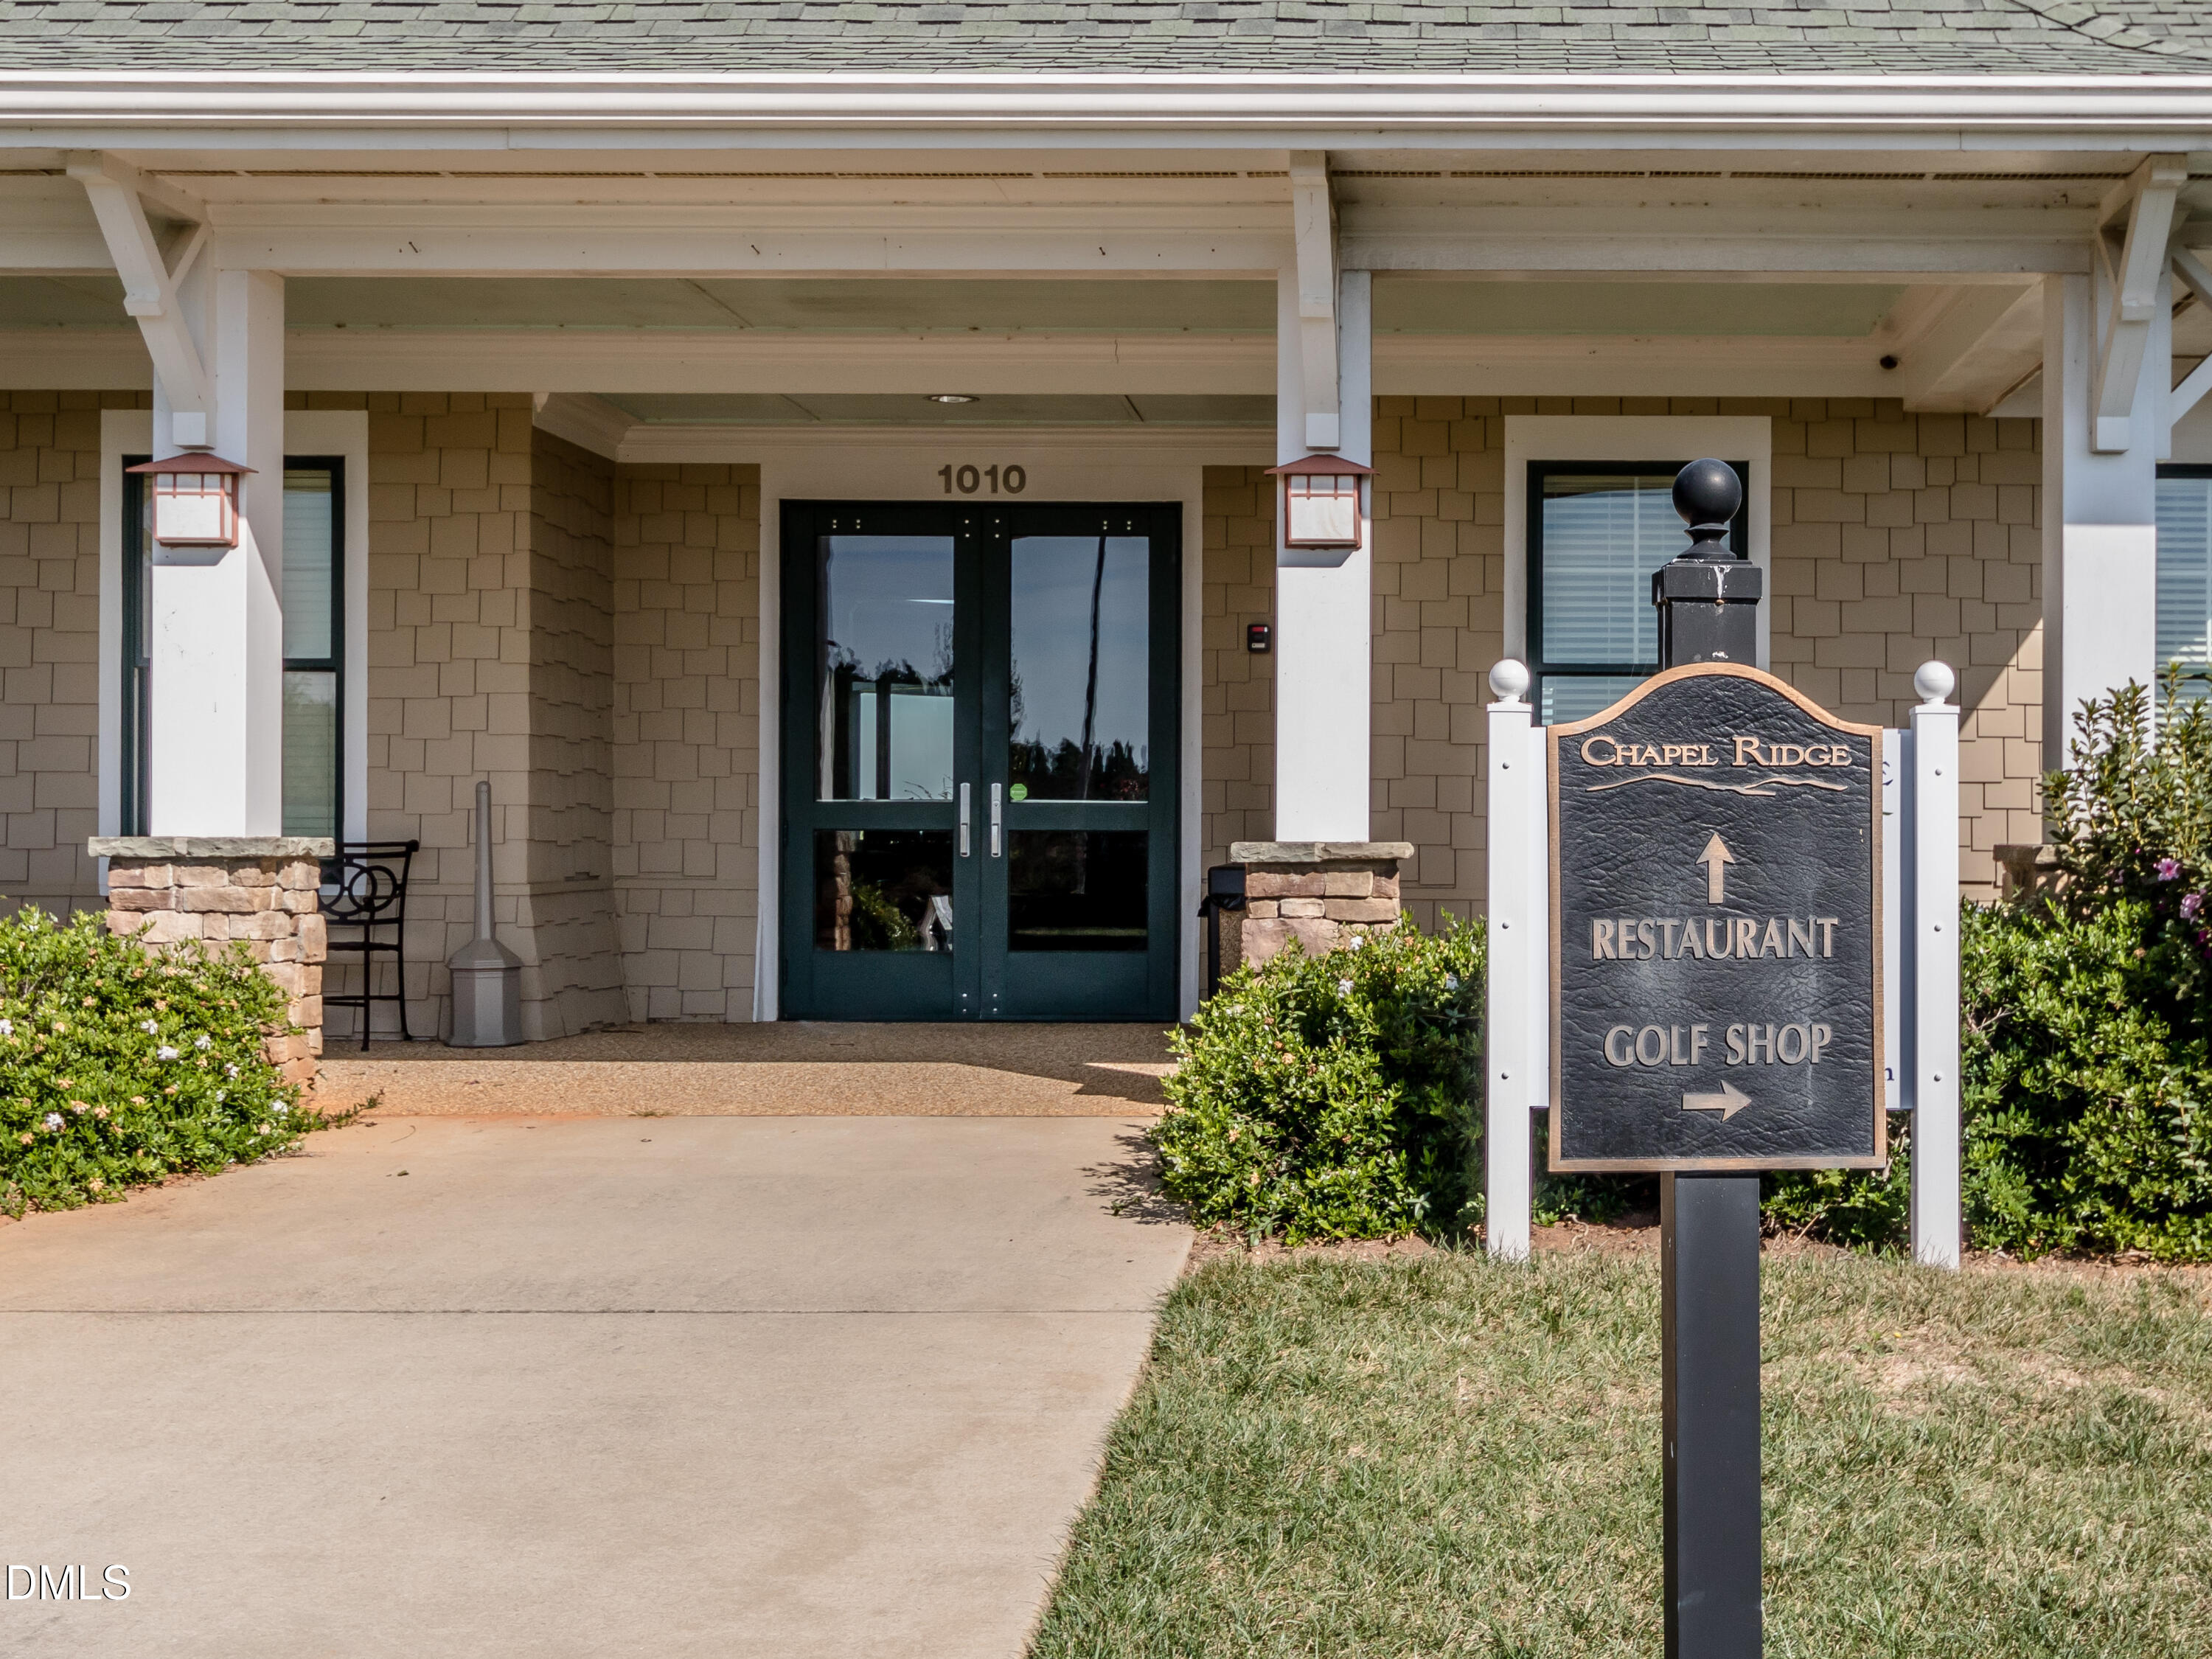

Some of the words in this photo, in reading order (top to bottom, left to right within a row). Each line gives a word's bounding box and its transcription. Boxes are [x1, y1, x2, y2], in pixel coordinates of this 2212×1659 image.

[937, 464, 1026, 495] 1010
[1580, 736, 1719, 768] CHAPEL
[1731, 736, 1853, 768] RIDGE
[1591, 917, 1839, 960] RESTAURANT
[1603, 1023, 1709, 1067] GOLF
[1725, 1023, 1832, 1066] SHOP
